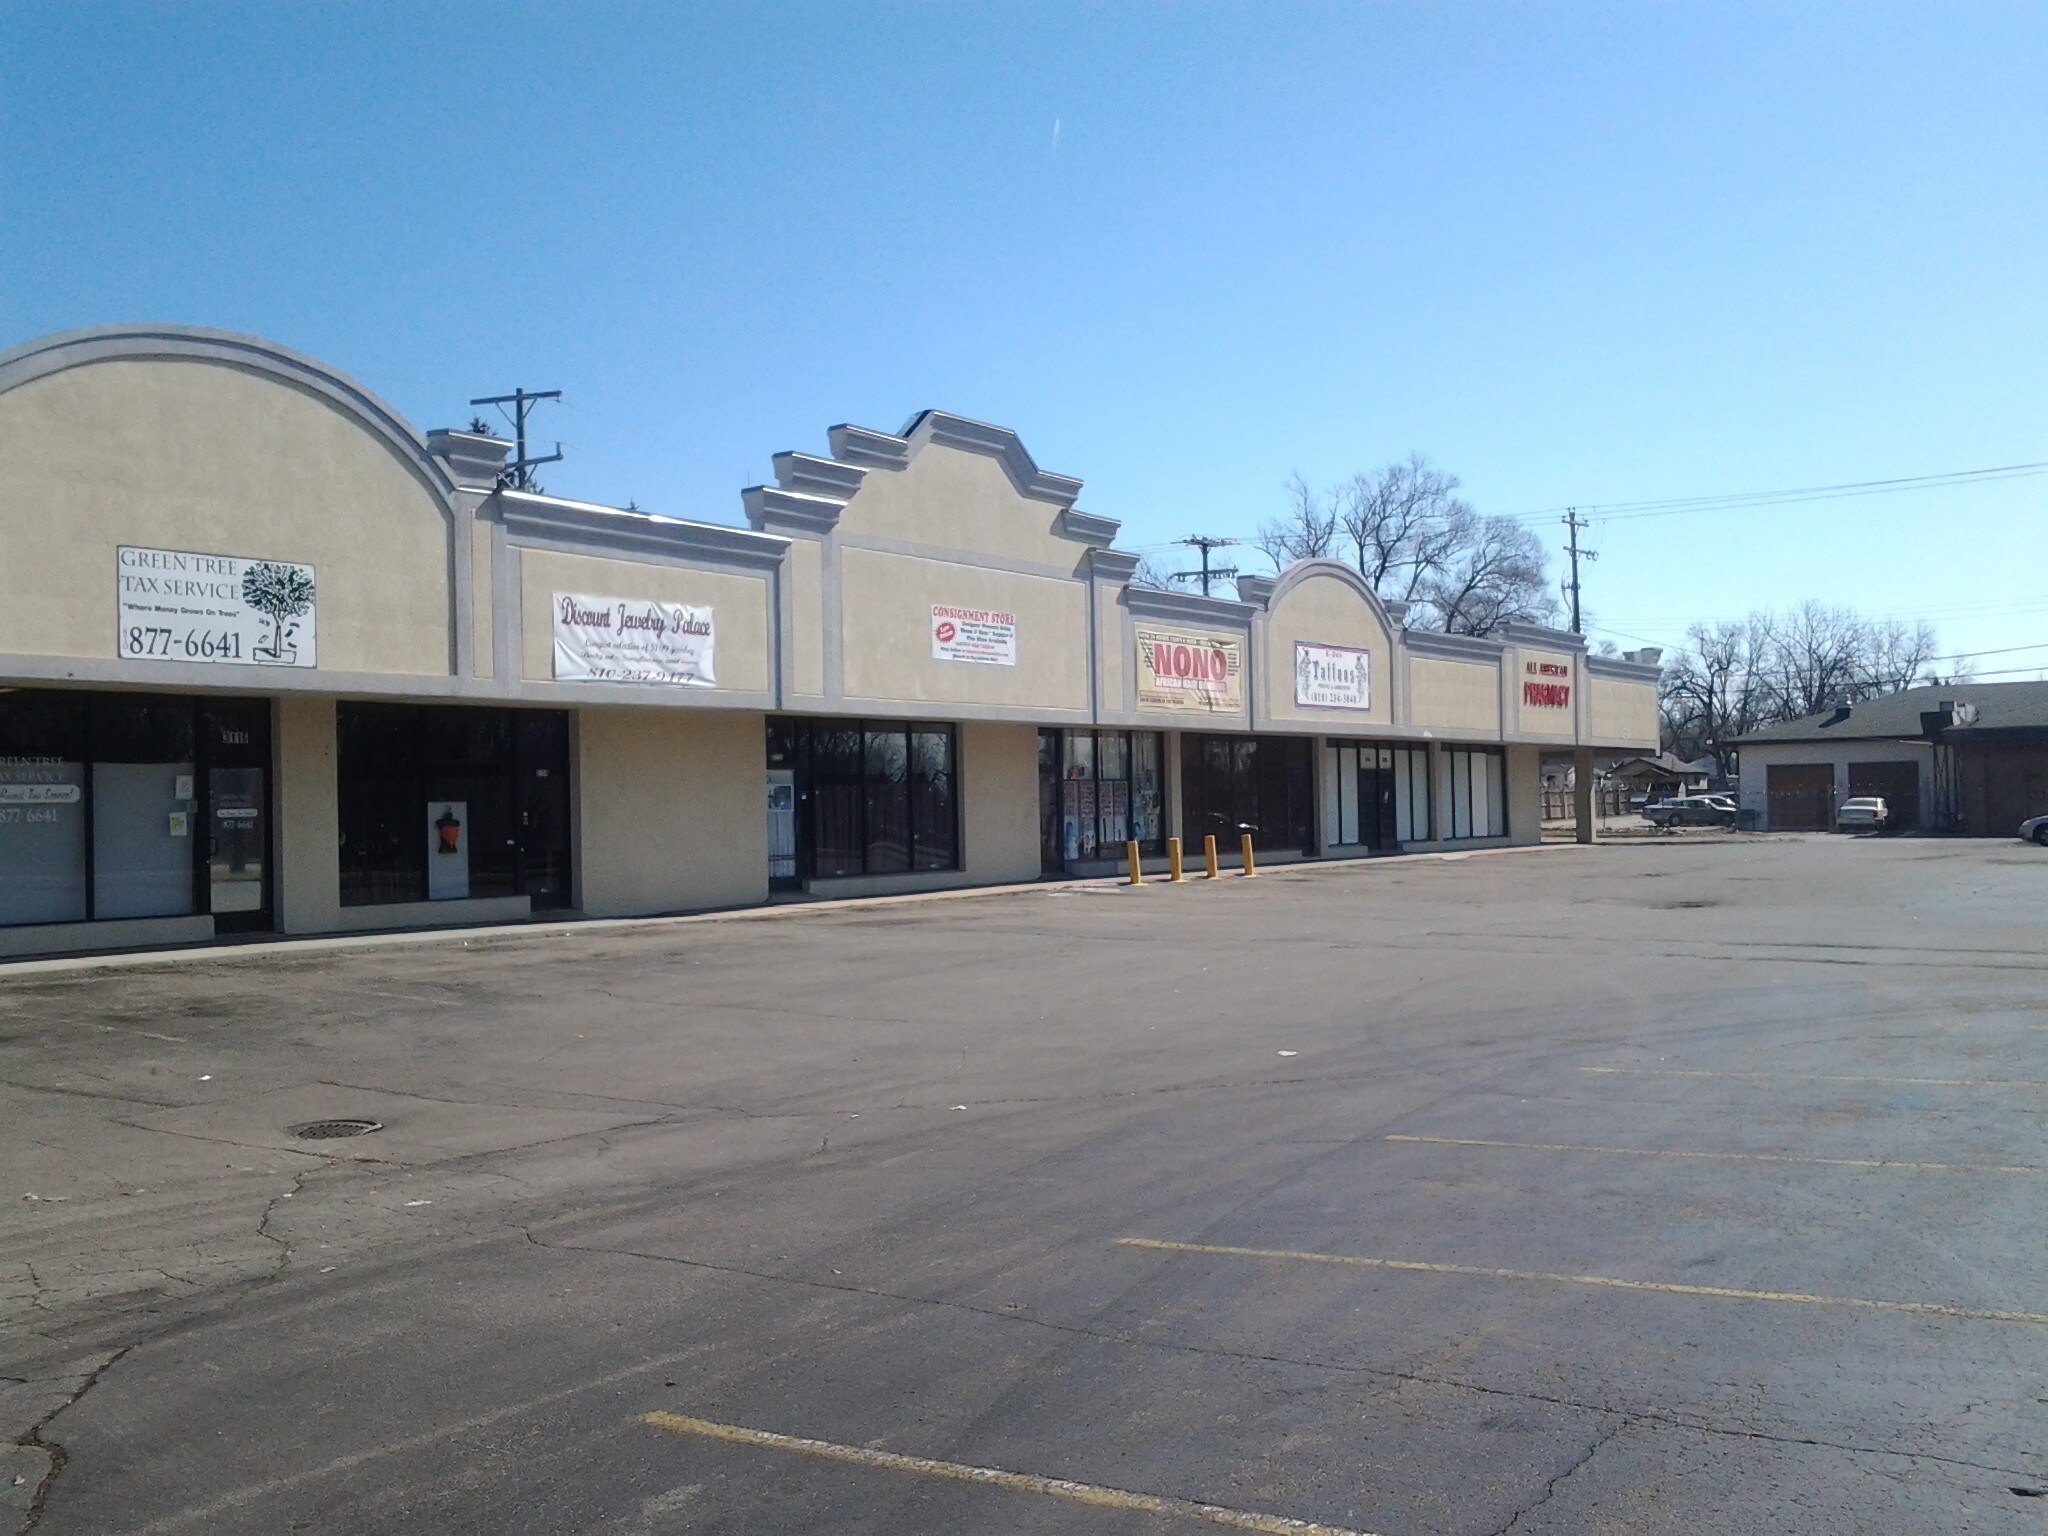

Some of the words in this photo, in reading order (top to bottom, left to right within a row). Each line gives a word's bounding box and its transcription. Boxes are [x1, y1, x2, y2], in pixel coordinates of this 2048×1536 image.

[120, 549, 187, 571] GREEN
[190, 556, 238, 577] TREE
[120, 575, 160, 595] TAX
[163, 579, 239, 601] SERVICE
[561, 596, 611, 629] Discount
[616, 603, 665, 639] Jewelry
[671, 608, 711, 637] Palace
[933, 606, 989, 623] CONSIGNMENT
[991, 612, 1015, 626] STORE
[129, 626, 243, 659] 877-6641
[1153, 643, 1227, 681] NONO
[1312, 660, 1355, 684] Tattoos
